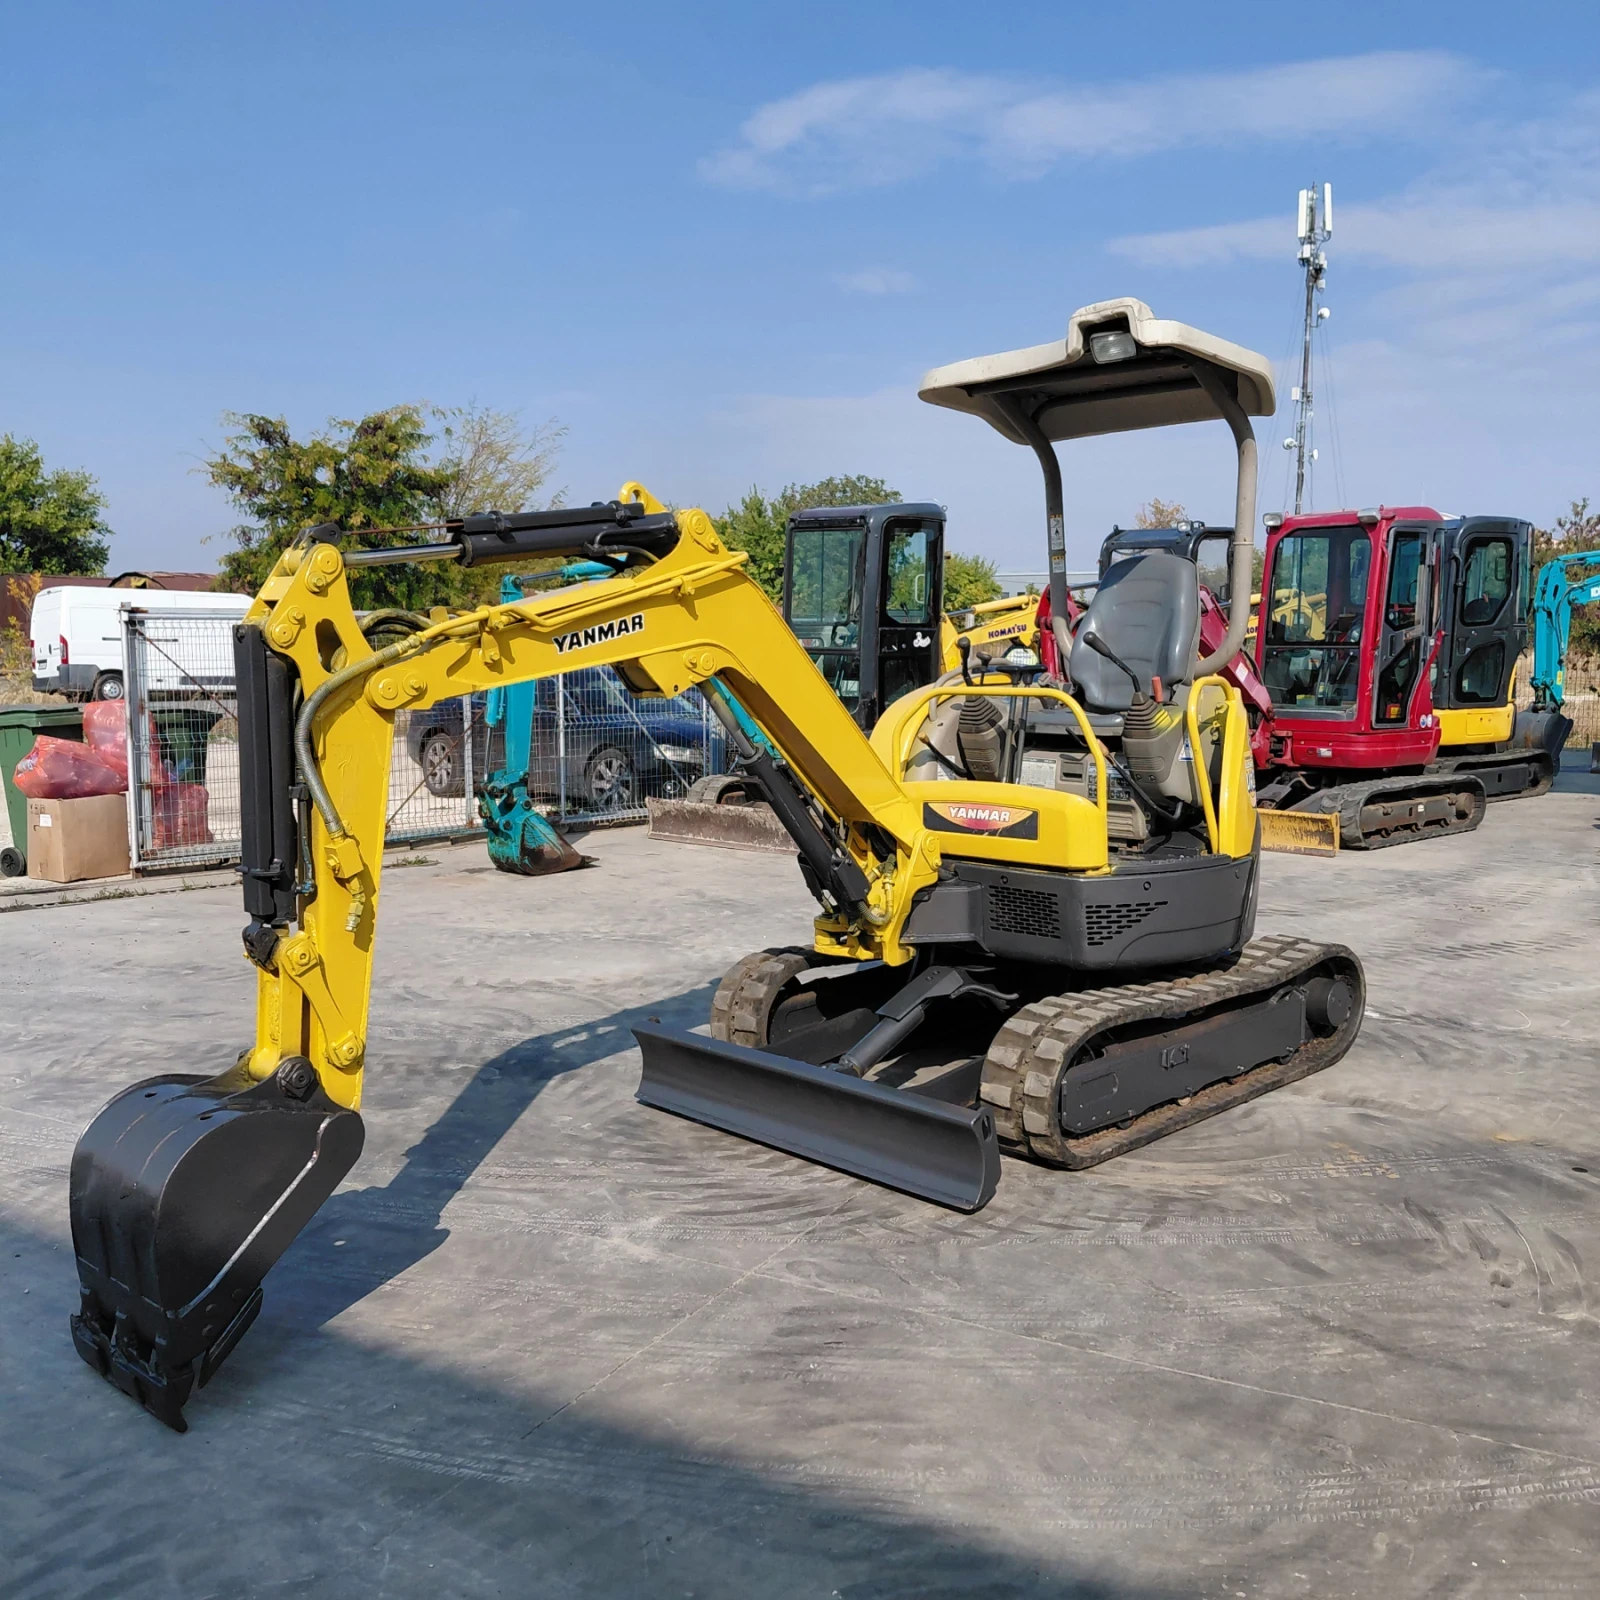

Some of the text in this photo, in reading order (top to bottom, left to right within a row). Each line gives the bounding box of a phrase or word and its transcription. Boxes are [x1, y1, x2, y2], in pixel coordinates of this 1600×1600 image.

[552, 613, 644, 654] YANMAR
[988, 624, 1027, 639] KOMATSU
[949, 806, 1010, 822] YANMAR
